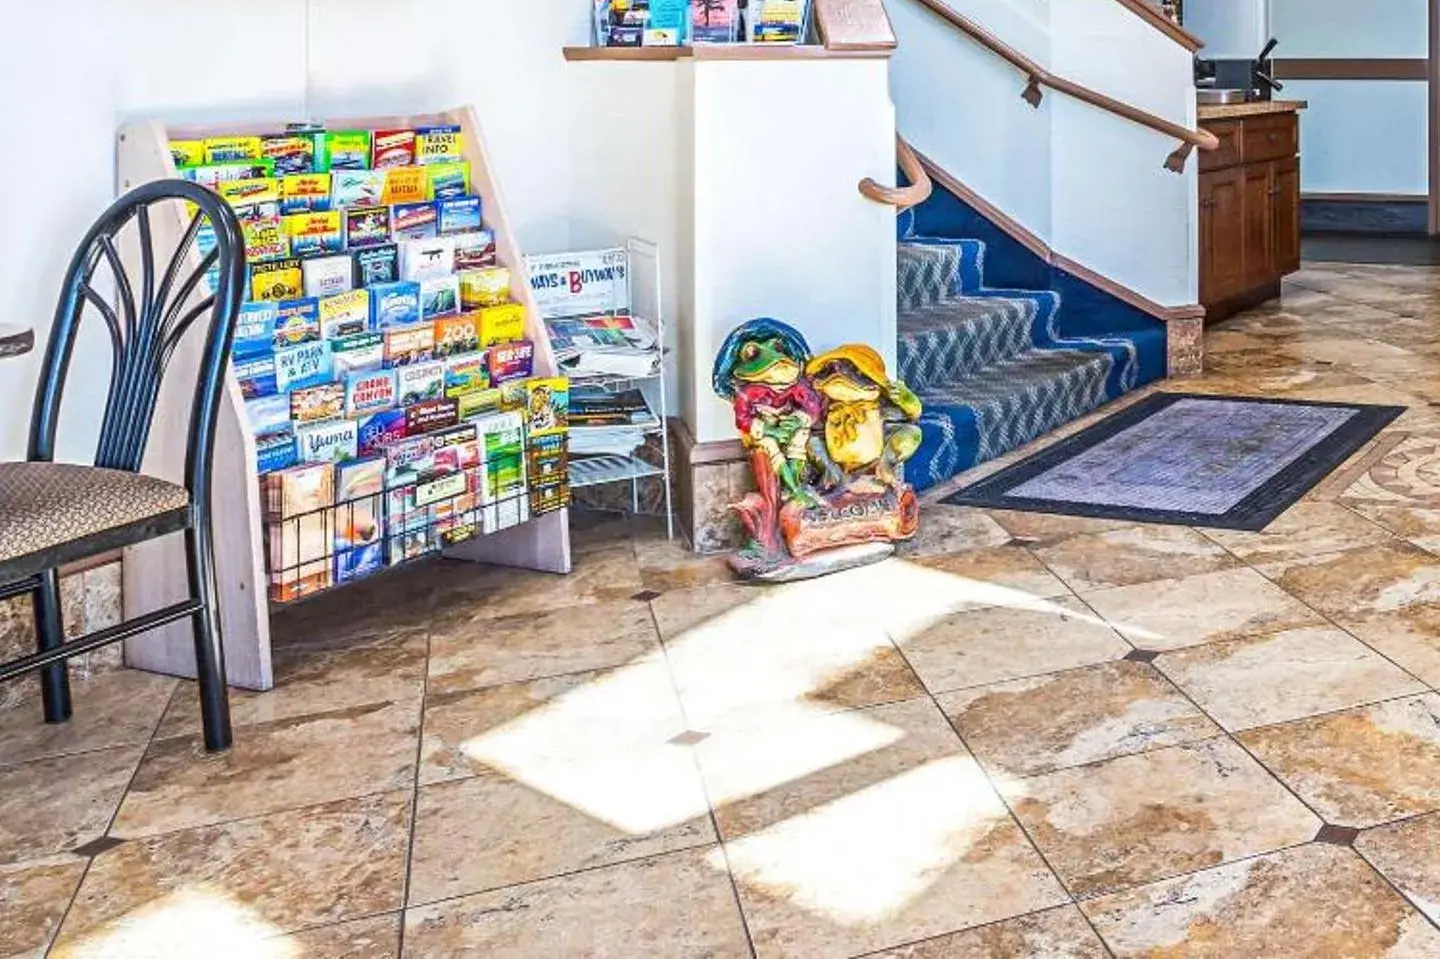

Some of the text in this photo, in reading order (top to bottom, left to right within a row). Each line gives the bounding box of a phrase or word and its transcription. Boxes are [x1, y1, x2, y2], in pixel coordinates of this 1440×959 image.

[422, 133, 456, 145] TRAVEL
[422, 144, 449, 154] INFO
[443, 323, 475, 342] ZOO
[280, 346, 324, 369] RV PARK
[356, 376, 389, 392] GRAND
[352, 387, 393, 404] CANYON
[308, 429, 354, 453] Yuma
